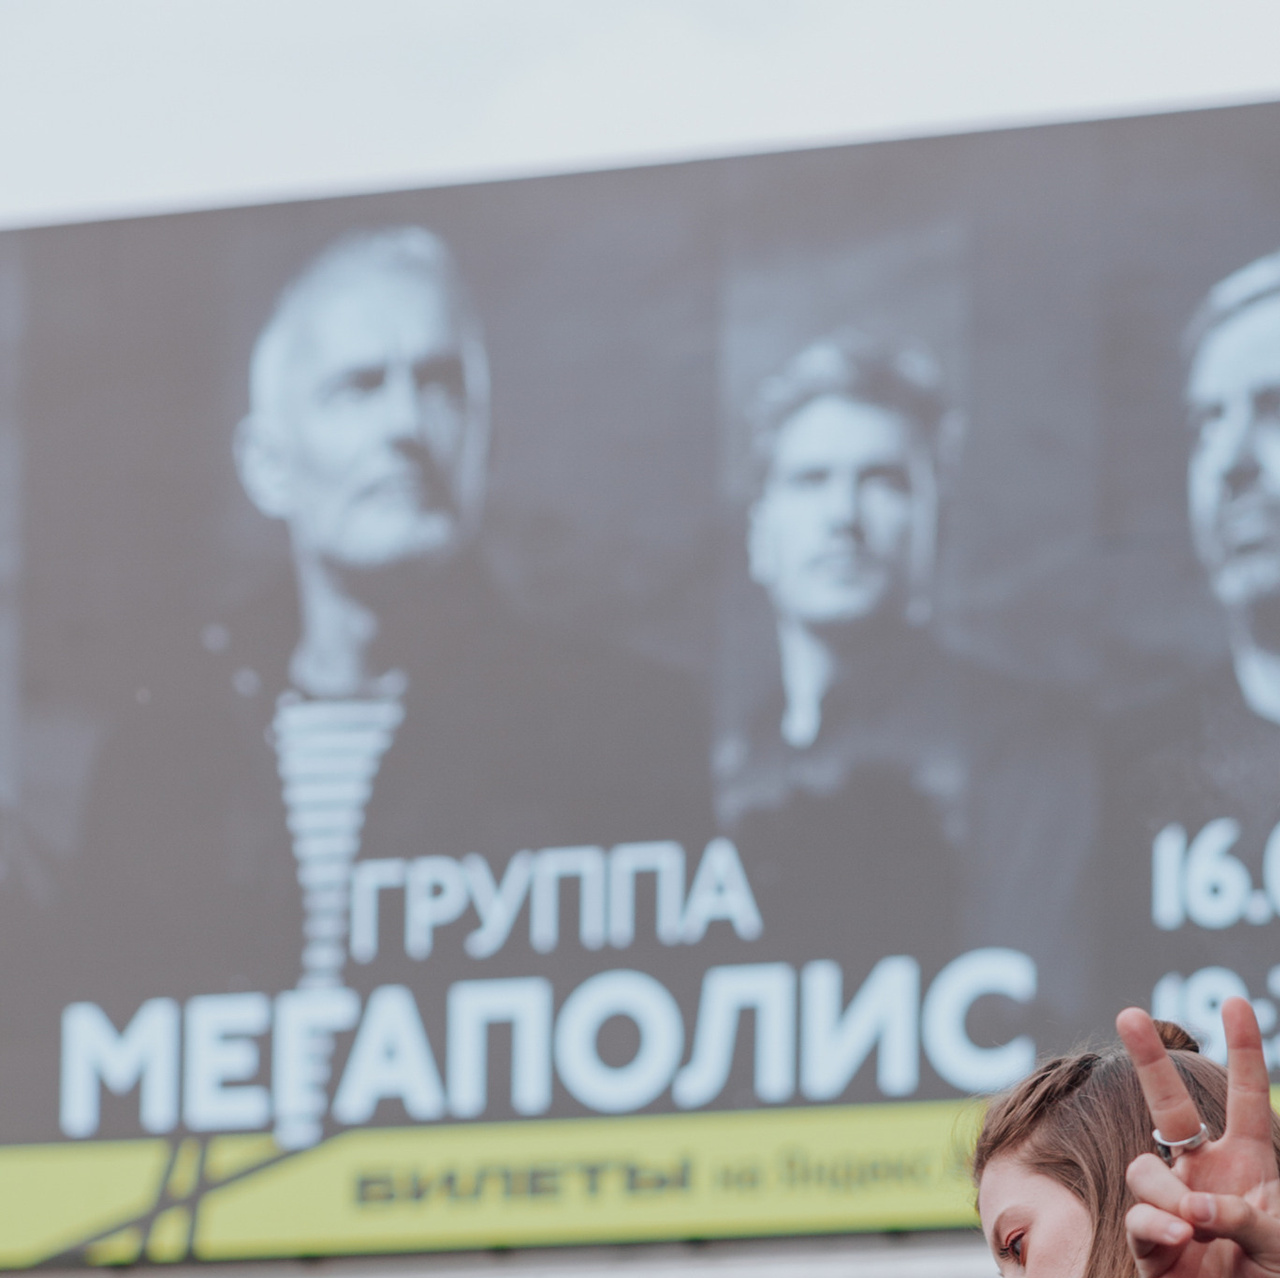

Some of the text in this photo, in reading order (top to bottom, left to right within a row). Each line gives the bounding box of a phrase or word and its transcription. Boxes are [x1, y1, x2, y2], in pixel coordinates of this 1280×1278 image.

[350, 838, 765, 962] ГРУППА
[58, 945, 1040, 1150] МЕГАПОЛИС
[350, 1158, 696, 1206] БИЛЕТЫ
